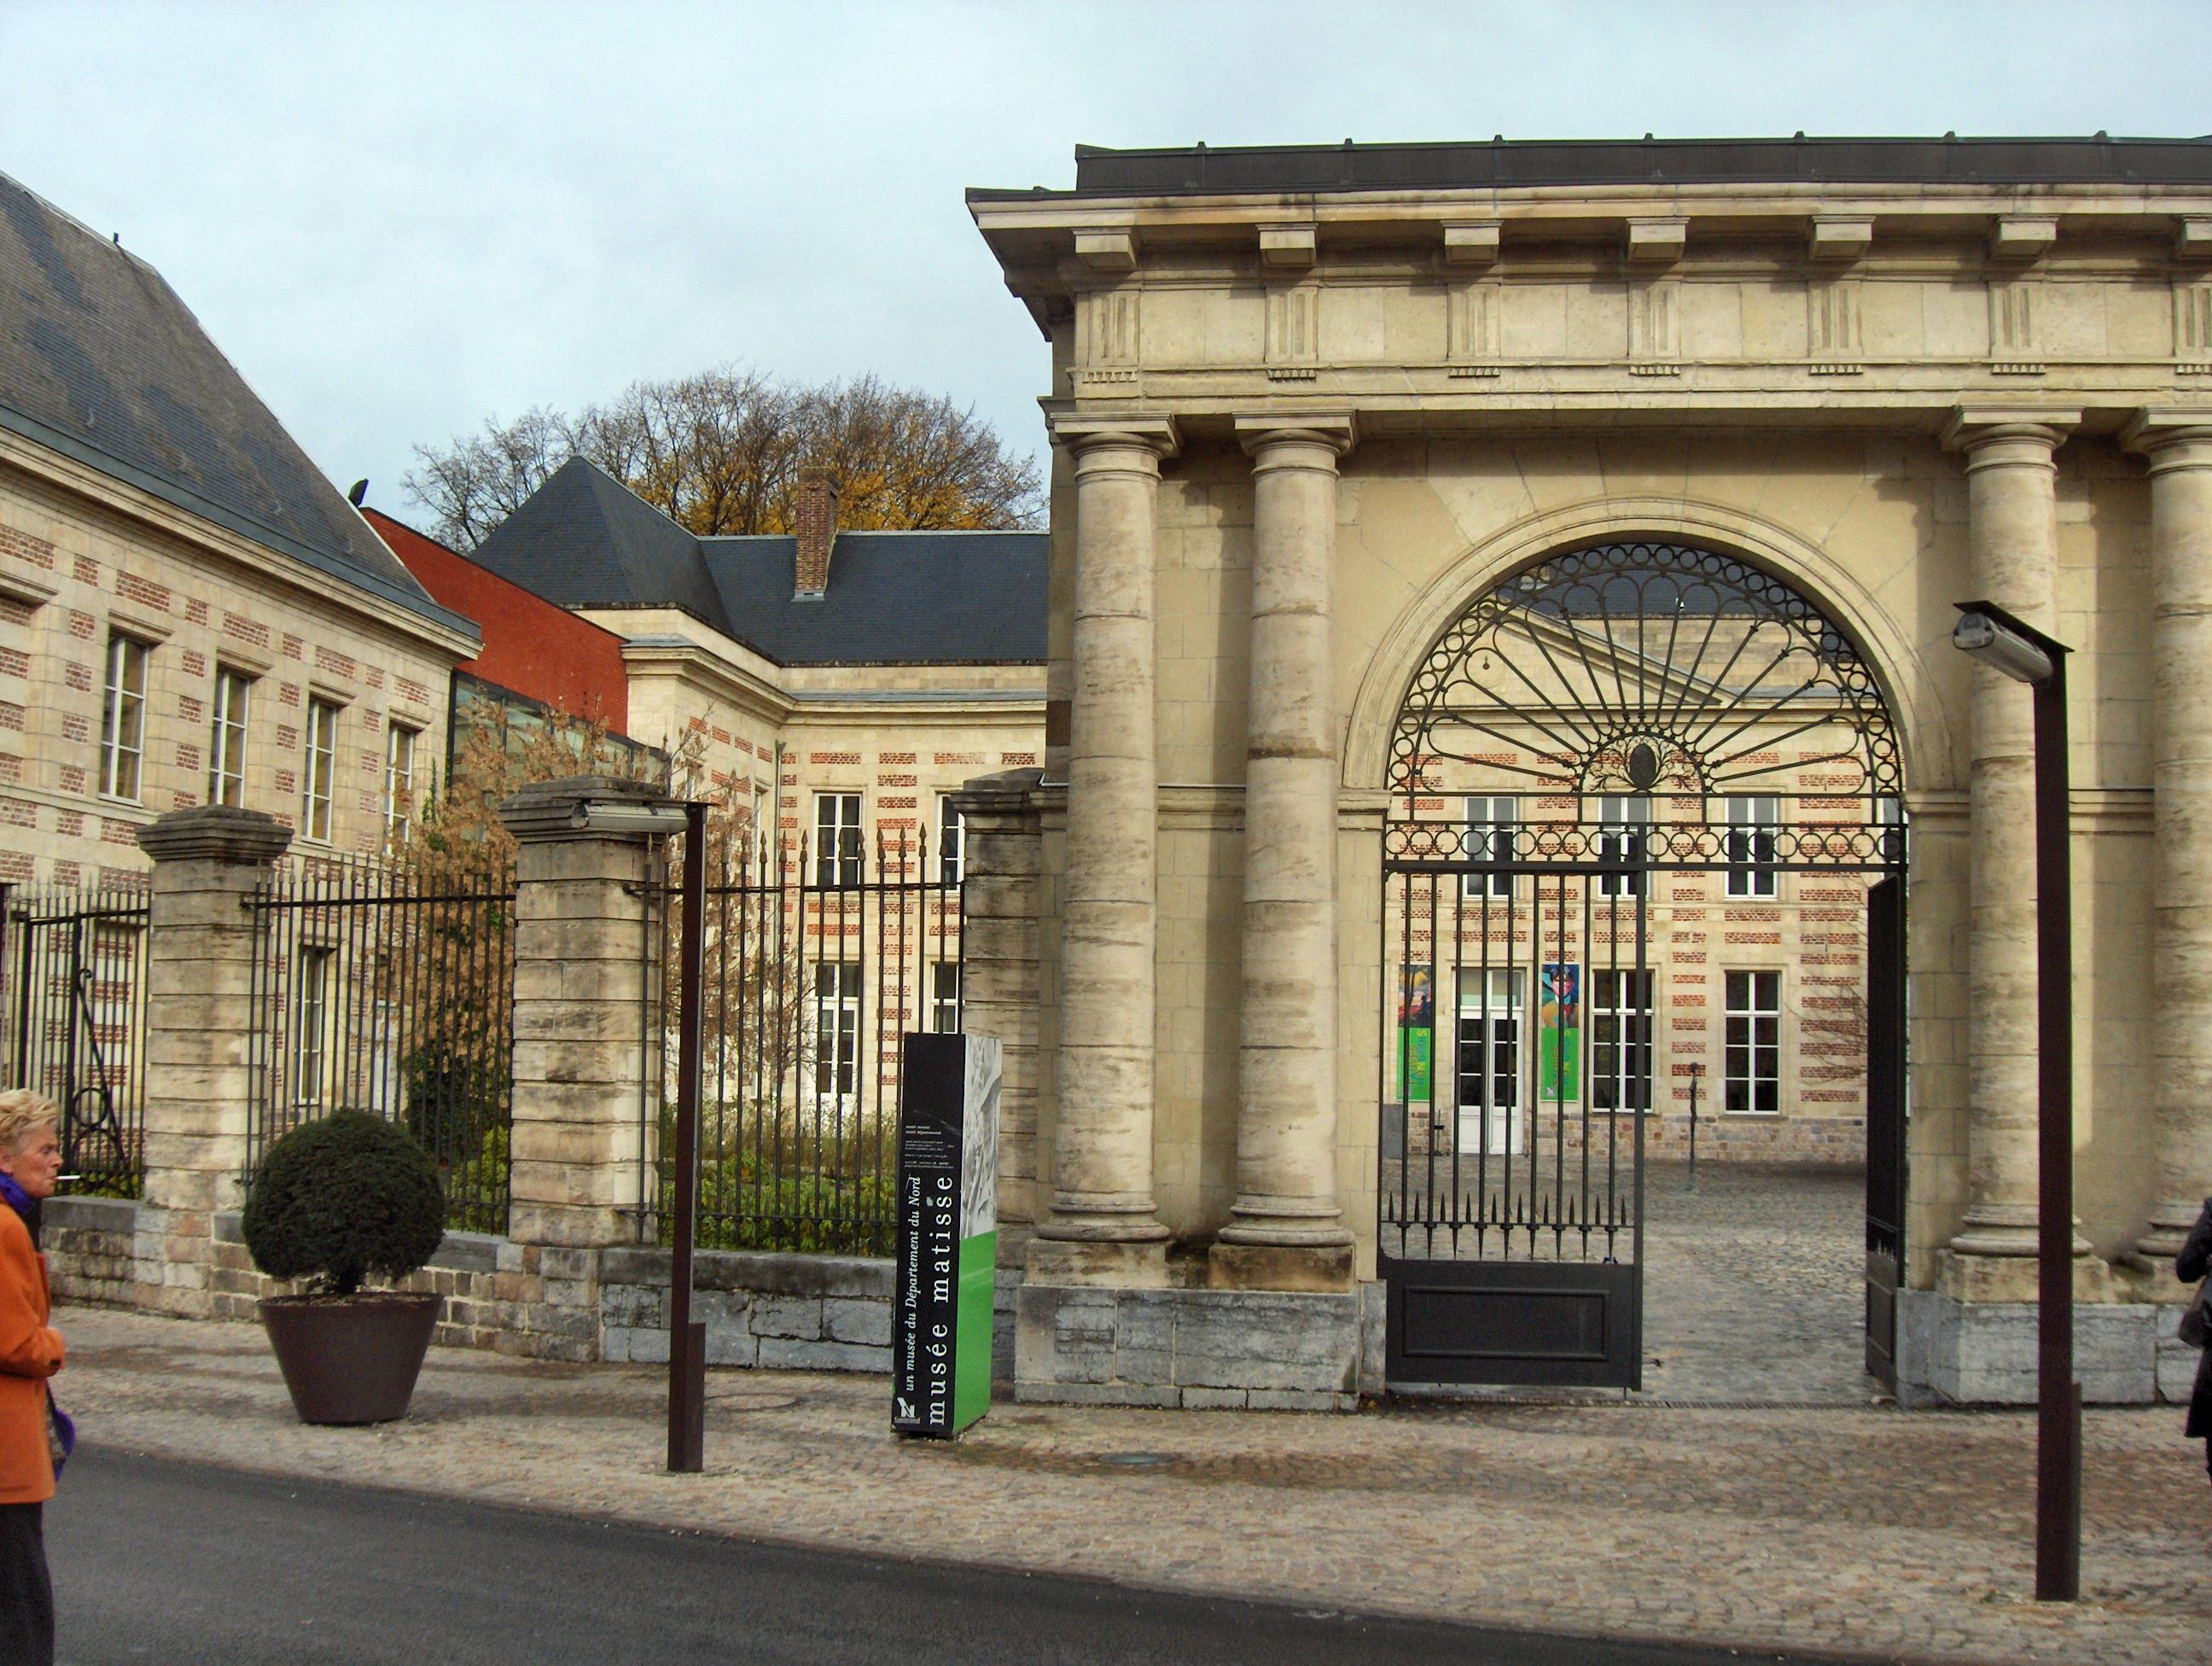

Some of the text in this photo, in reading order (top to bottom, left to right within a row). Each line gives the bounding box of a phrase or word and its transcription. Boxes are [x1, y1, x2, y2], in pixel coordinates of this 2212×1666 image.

[904, 1176, 921, 1392] un musée du Département du Nord
[929, 1177, 953, 1303] matisse
[926, 1324, 948, 1426] musée
